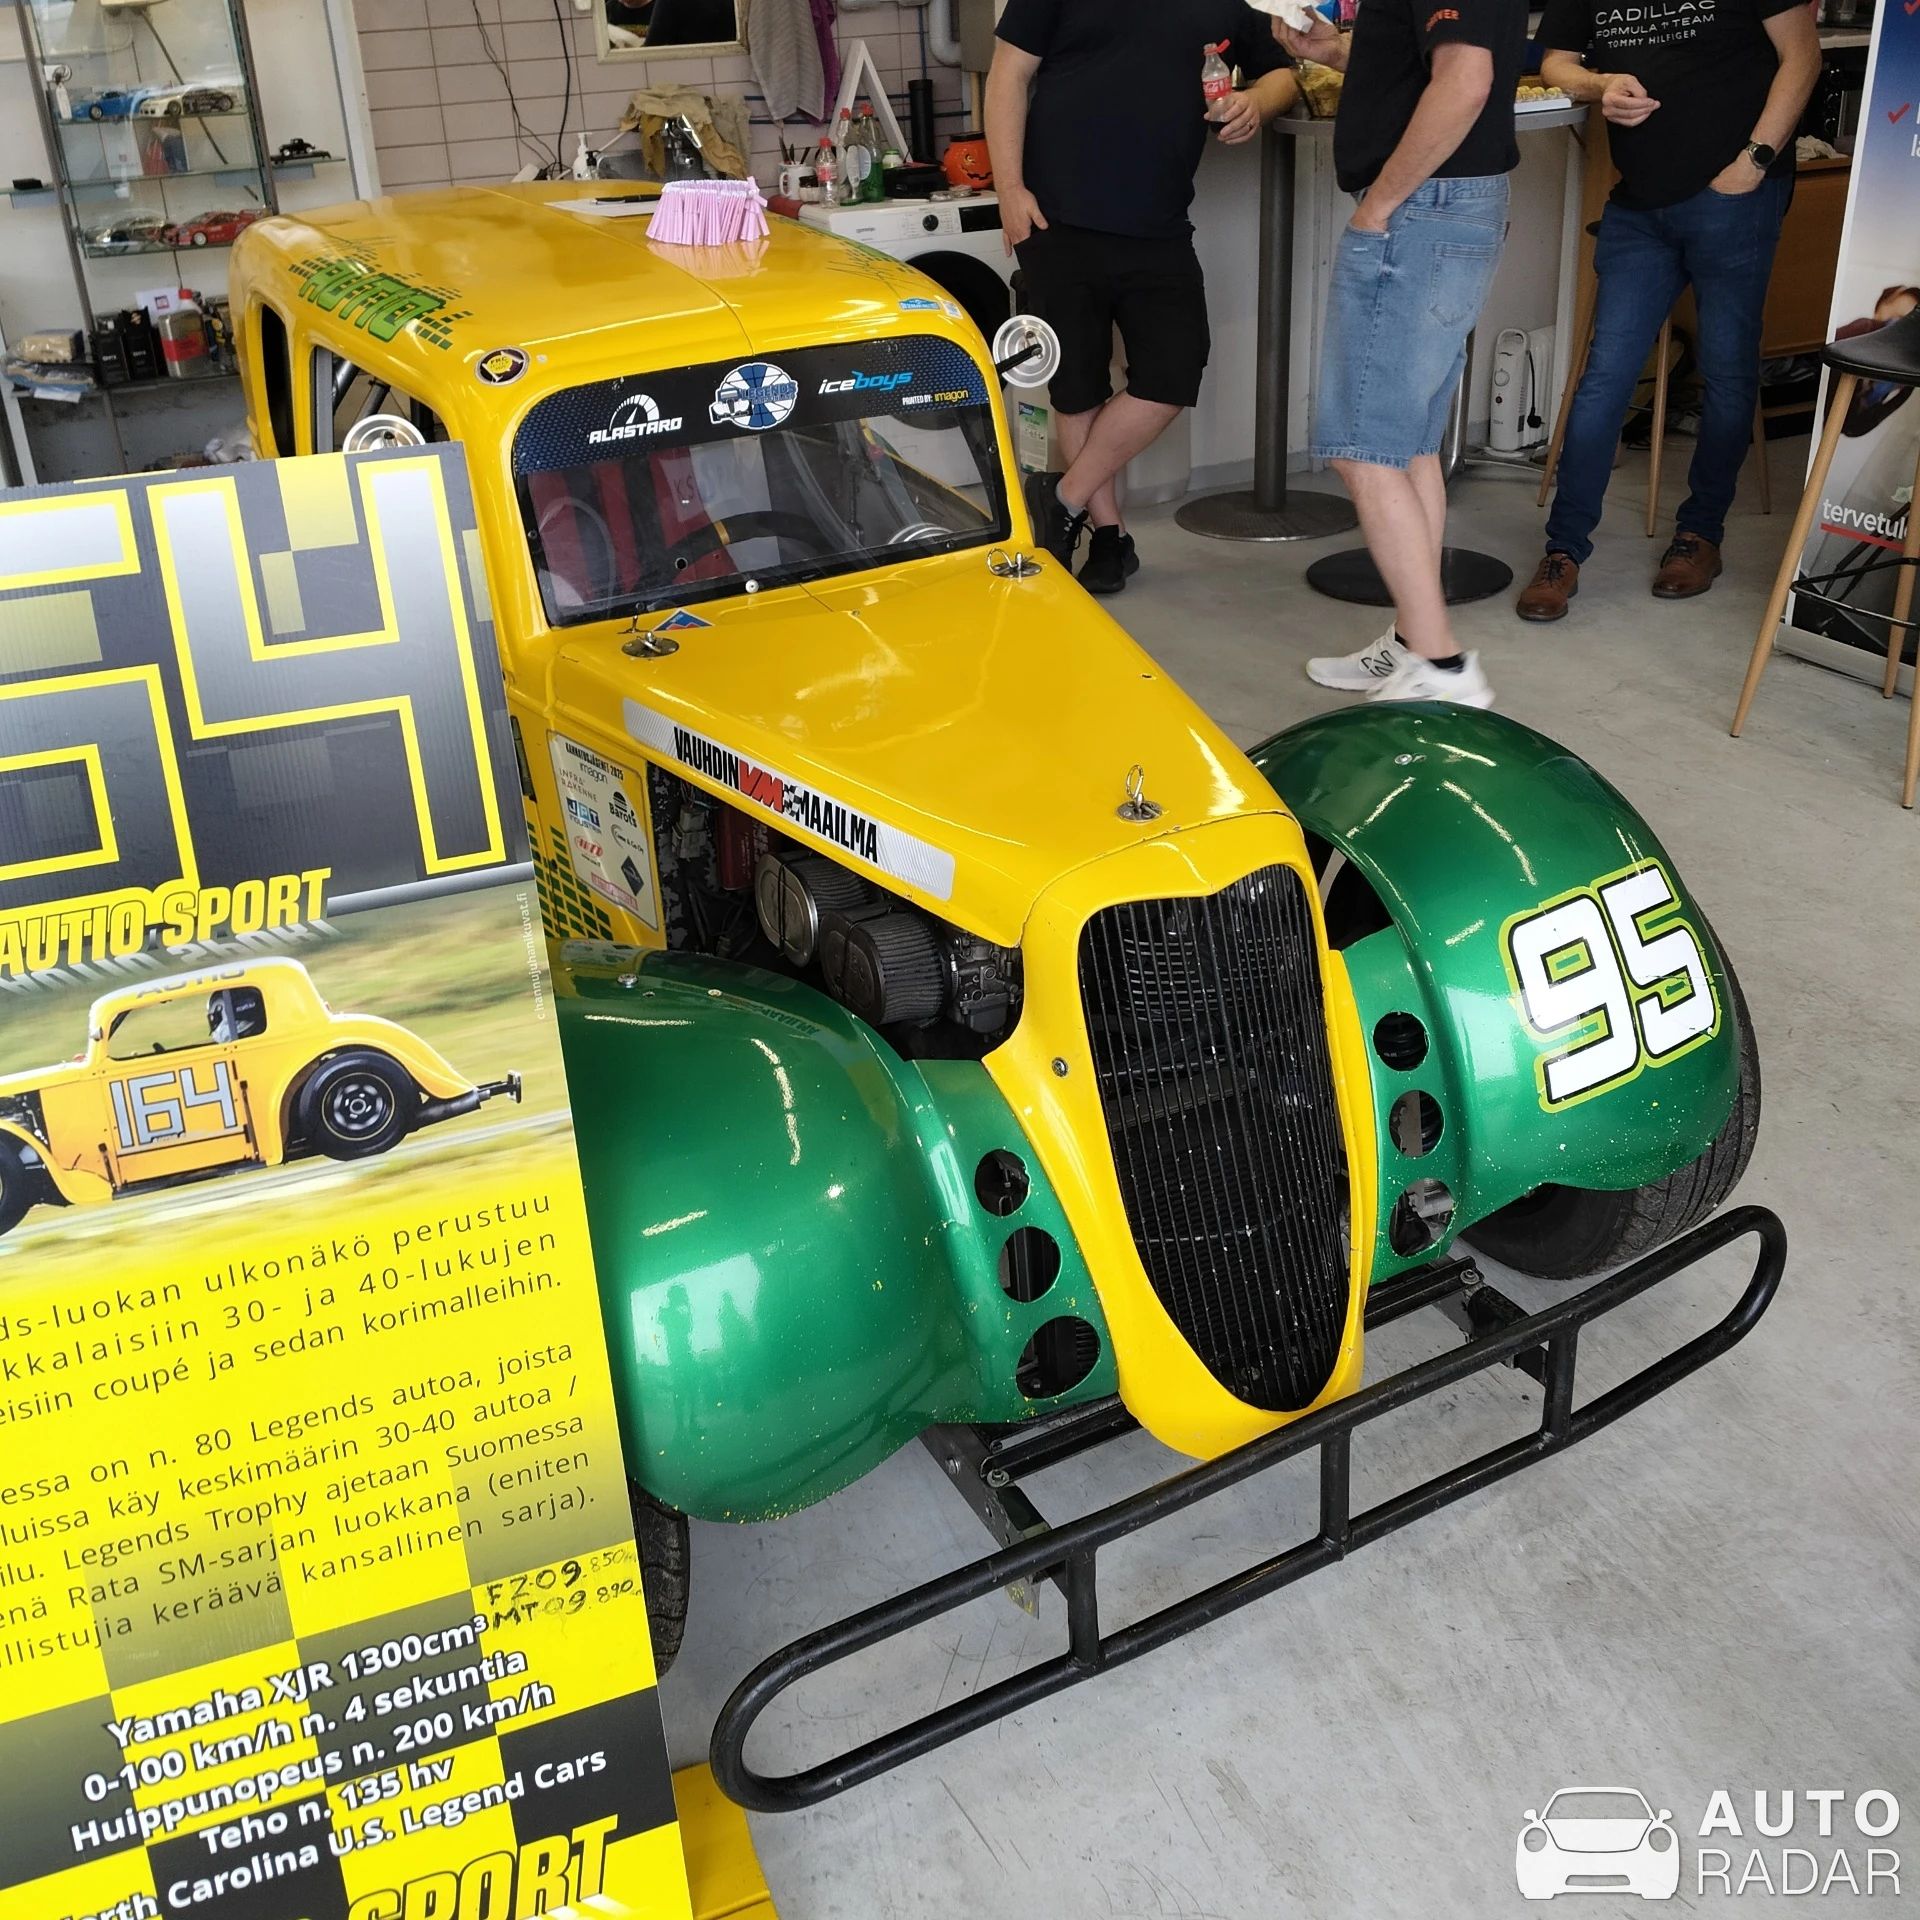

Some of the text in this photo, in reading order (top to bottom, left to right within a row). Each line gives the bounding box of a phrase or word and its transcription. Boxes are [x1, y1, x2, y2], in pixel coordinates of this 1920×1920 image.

[1595, 0, 1716, 25] CADILLAC
[1596, 24, 1658, 39] FORMULA
[1672, 14, 1715, 27] TEAM
[1608, 29, 1697, 49] TOMMY HILFIGER
[588, 416, 683, 445] ALASTARO
[740, 382, 798, 400] LEGENDS
[818, 370, 914, 395] iceboys
[902, 395, 924, 405] PRINTED
[1823, 498, 1909, 540] tervetul
[609, 764, 624, 780] 2025
[674, 726, 740, 791] VAUHDIN
[795, 789, 878, 863] MAAILMA
[0, 867, 332, 977] AUTIO SPORT
[1505, 860, 1719, 1108] 95
[109, 1060, 238, 1149] 164
[205, 1234, 370, 1292] ulkonäkö
[393, 1195, 550, 1254] perustuu
[3, 1233, 556, 1382] kkalaisiin 30- ja 40-lukujen
[93, 1356, 190, 1401] coupé
[208, 1351, 235, 1381] ja
[254, 1324, 345, 1362] sedan
[363, 1271, 562, 1335] korimalleihin.
[0, 1374, 578, 1547] luissa käy keskimäärin 30-40 autoa /
[1, 1343, 573, 1506] essa on n. 80 Legends autoa, joista
[63, 1521, 190, 1570] Legends
[204, 1490, 307, 1532] Trophy
[326, 1458, 429, 1504] ajetaan
[445, 1416, 583, 1468] Suomessa
[68, 1575, 139, 1609] Rata
[158, 1527, 316, 1585] SM-sarjan
[334, 1485, 470, 1537] luokkana
[488, 1451, 589, 1497] (eniten
[0, 1486, 595, 1668] llistujia keräävä kansallinen sarja).
[83, 1650, 527, 1801] 0-100 km/h n. 4 sekuntia
[106, 1615, 488, 1749] Yamaha XJR 1300cm³
[71, 1681, 555, 1851] Huippunopeus n. 200 km/h
[199, 1755, 454, 1854] Teho n. 135 hv
[167, 1843, 319, 1909] Carolina
[327, 1818, 395, 1856] U.S.
[401, 1771, 525, 1836] Legend
[534, 1751, 607, 1789] Cars
